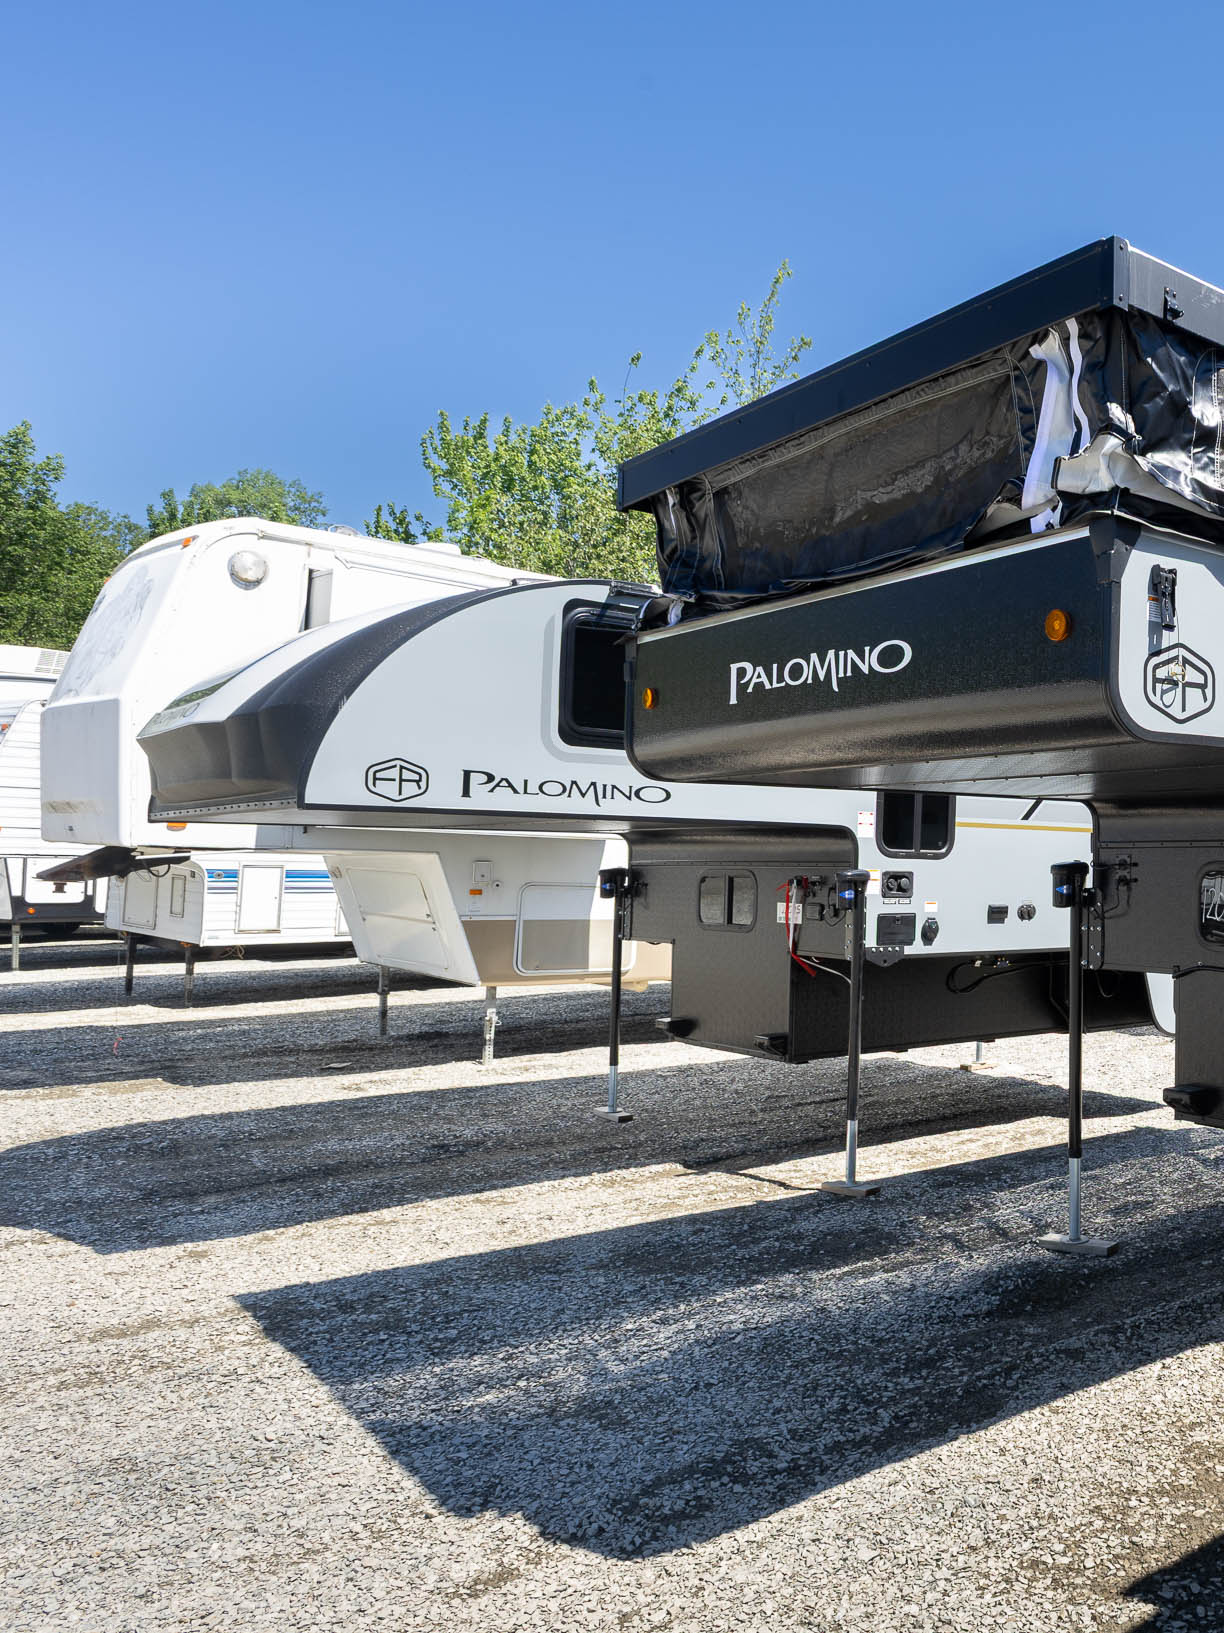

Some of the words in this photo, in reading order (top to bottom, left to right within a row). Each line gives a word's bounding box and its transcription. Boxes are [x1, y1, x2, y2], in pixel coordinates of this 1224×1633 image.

[729, 639, 912, 705] PALOMINO
[371, 763, 424, 797] FR
[461, 769, 671, 807] PALOMINO
